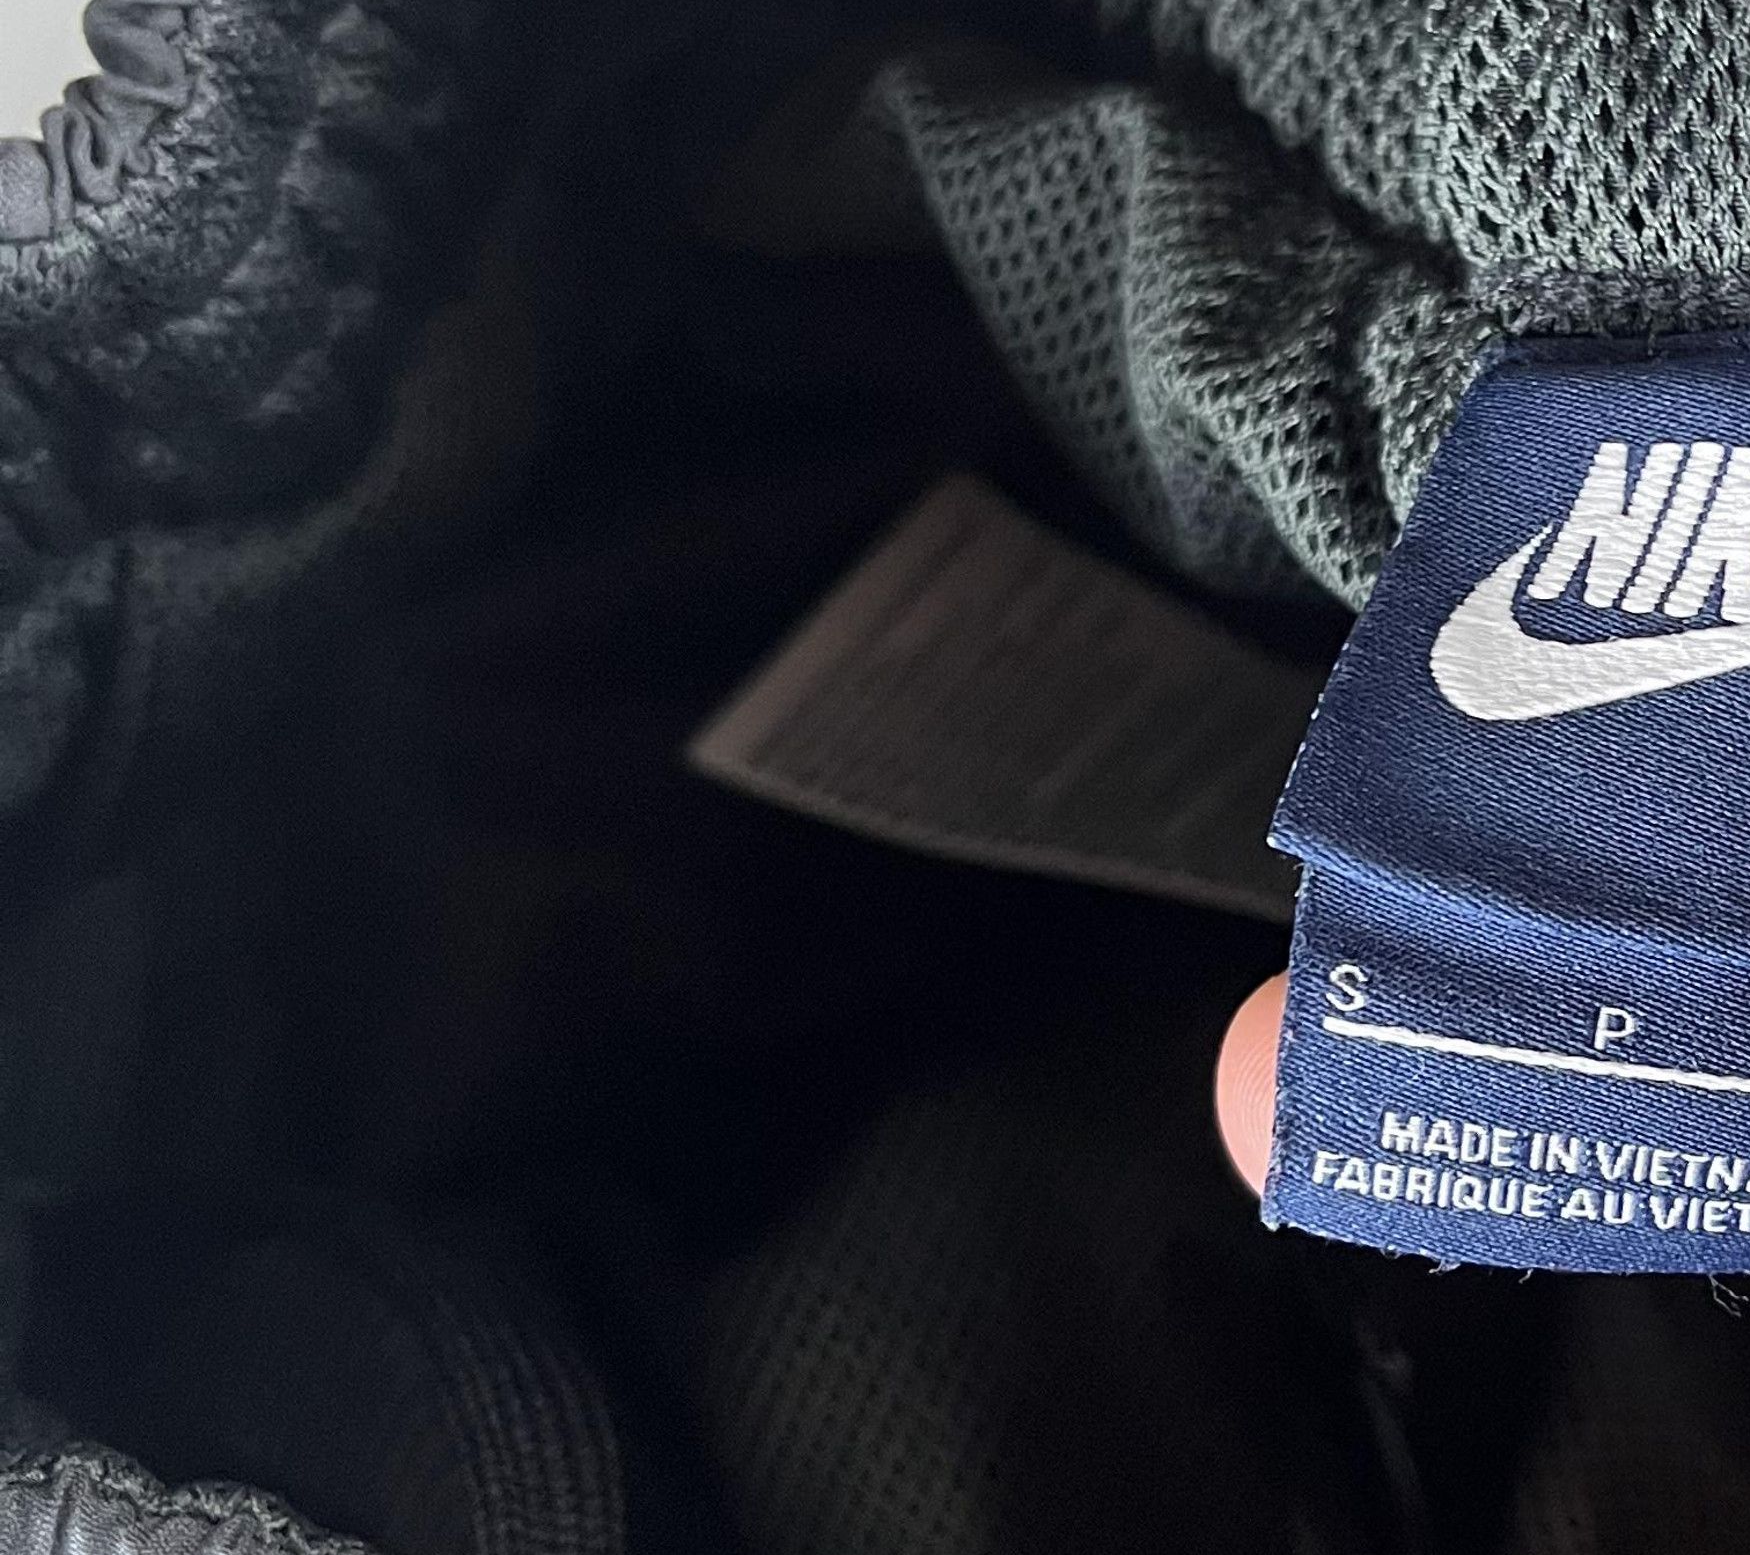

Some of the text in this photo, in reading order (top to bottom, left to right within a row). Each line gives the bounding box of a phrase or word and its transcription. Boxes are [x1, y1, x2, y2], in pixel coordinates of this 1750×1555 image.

[1324, 963, 1370, 1013] S
[1592, 1006, 1637, 1052] P
[1379, 1111, 1516, 1170] MADE
[1529, 1133, 1594, 1176] IN
[1311, 1150, 1552, 1219] FABRIQUE
[1559, 1185, 1639, 1226] AU
